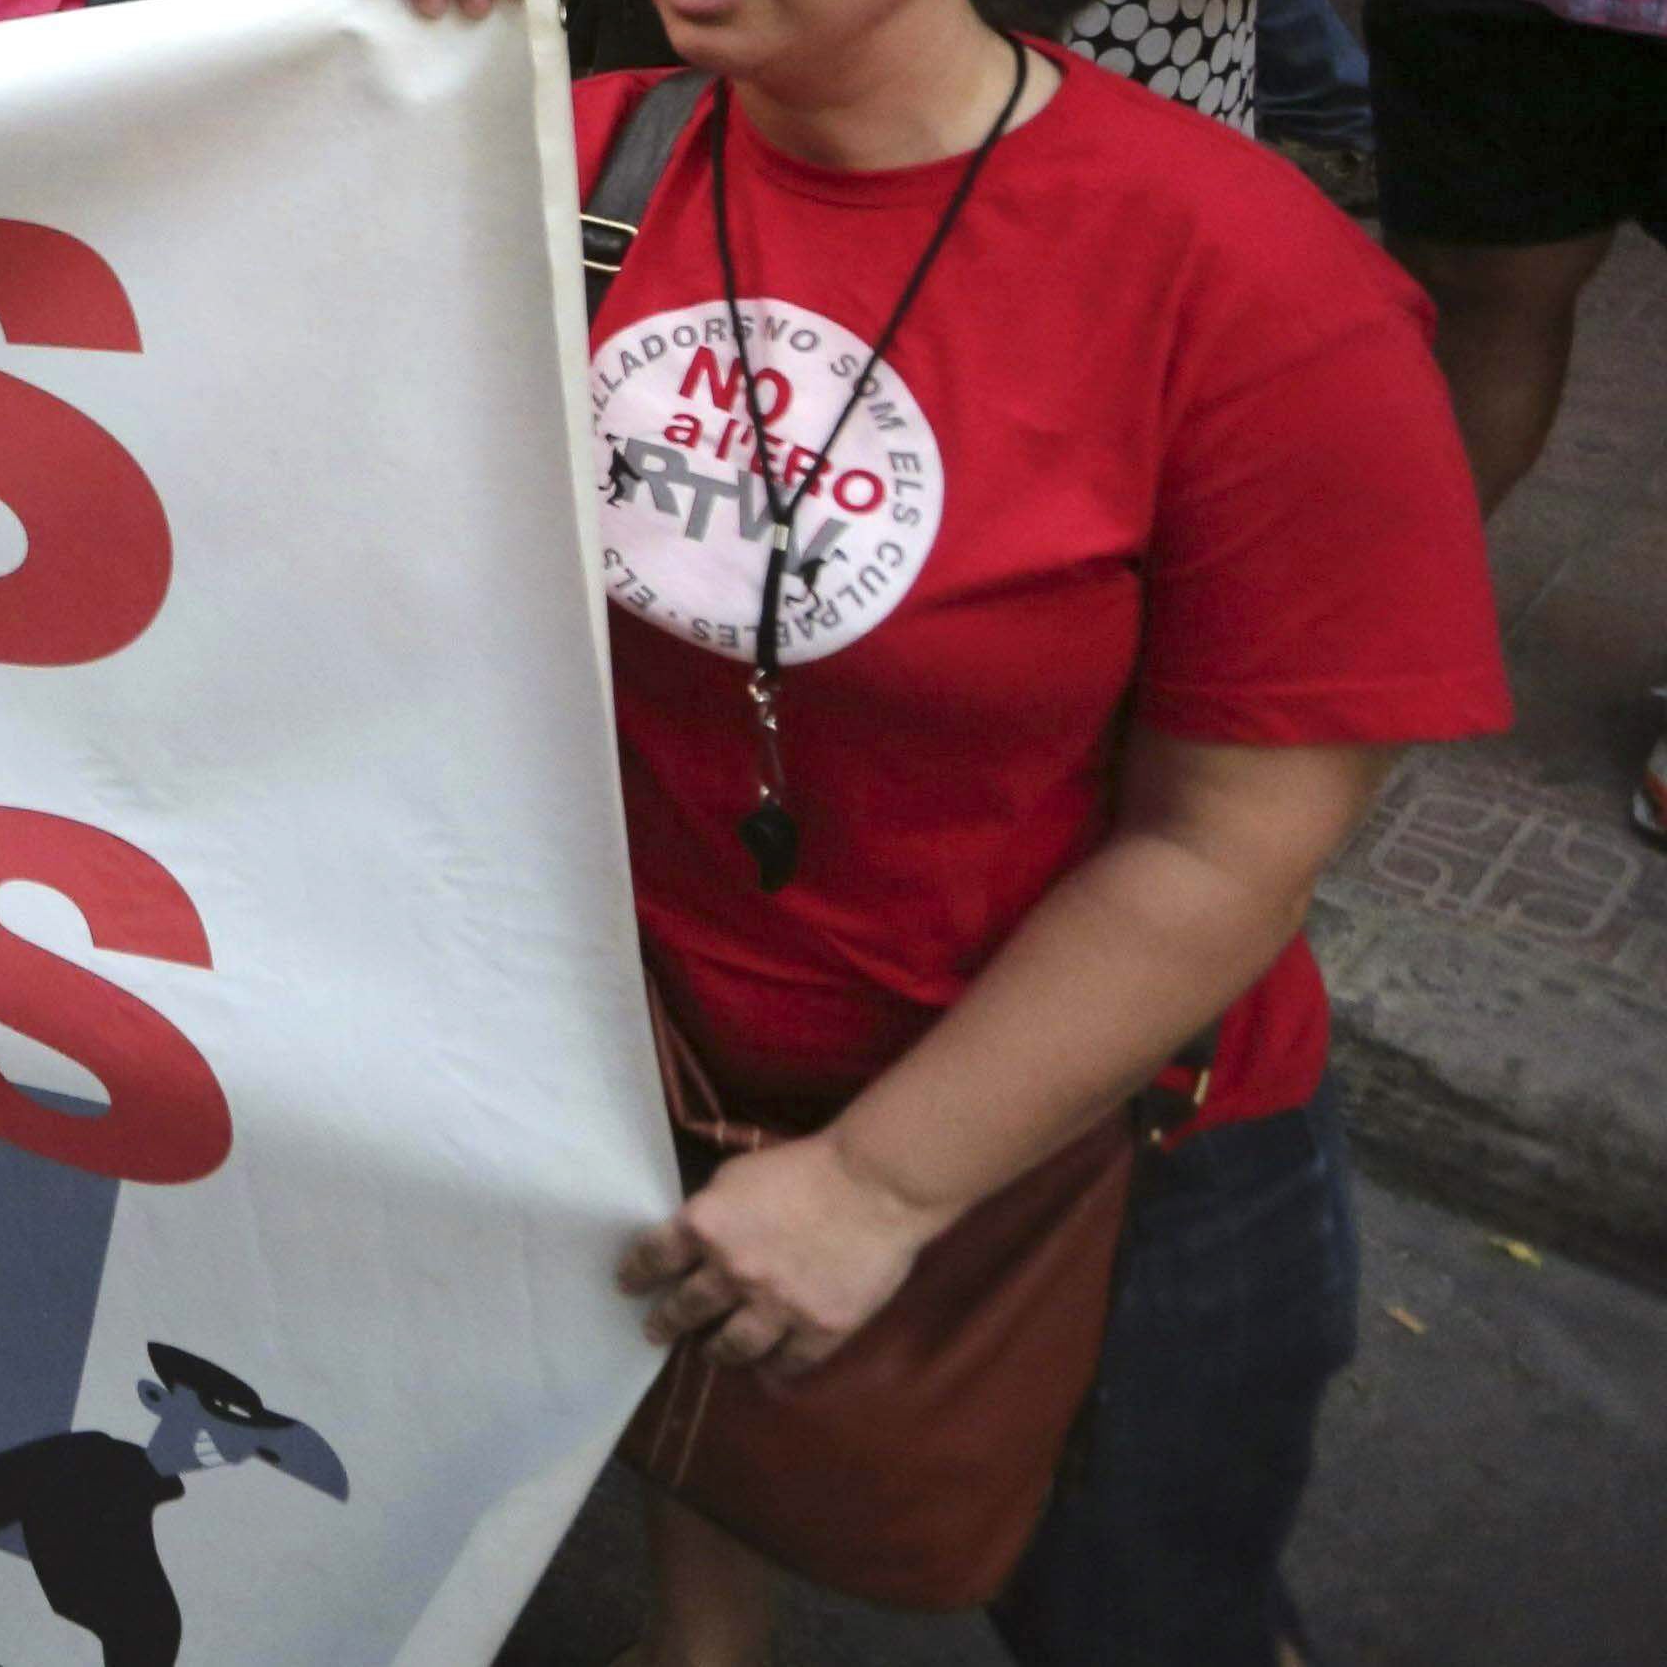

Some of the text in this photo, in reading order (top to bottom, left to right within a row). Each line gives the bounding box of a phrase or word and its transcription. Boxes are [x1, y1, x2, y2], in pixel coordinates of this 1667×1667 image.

[679, 345, 793, 426] NO
[765, 315, 821, 353] NO
[888, 448, 923, 528] ELS
[664, 413, 703, 448] a
